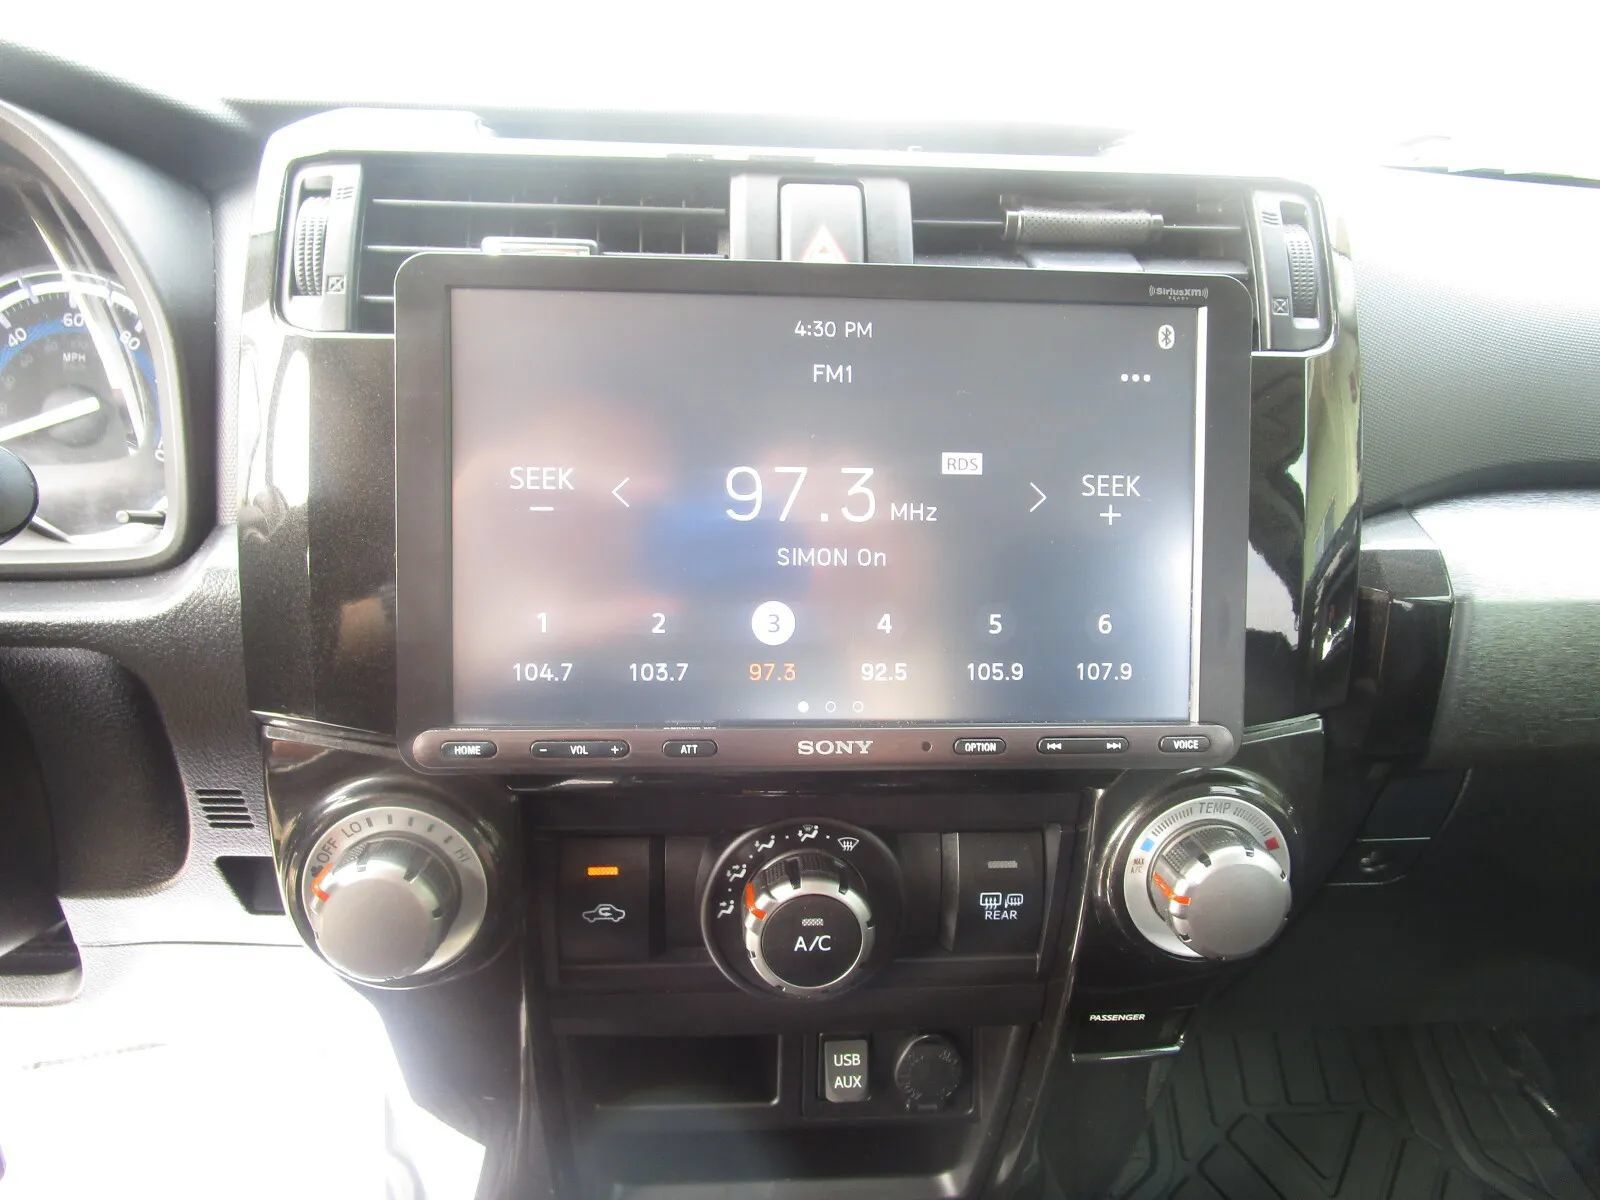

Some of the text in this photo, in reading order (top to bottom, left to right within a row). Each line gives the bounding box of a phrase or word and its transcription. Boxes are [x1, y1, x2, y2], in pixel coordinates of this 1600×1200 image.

[63, 312, 84, 327] 60
[8, 328, 27, 347] 40
[794, 320, 873, 338] 4:30 PM
[119, 331, 140, 350] 80
[63, 352, 86, 361] MPH
[812, 364, 853, 384] FM1
[946, 456, 979, 472] RDS
[509, 466, 575, 491] SEEK
[1080, 474, 1141, 498] SEEK
[725, 465, 938, 523] 97.3 MHz
[776, 547, 888, 567] SIMON On
[537, 612, 549, 633] 1
[651, 612, 666, 634] 2
[766, 613, 781, 634] 3
[876, 613, 893, 634] 4
[988, 613, 1003, 635] 5
[1098, 613, 1113, 635] 6
[512, 662, 574, 682] 104.7
[628, 662, 690, 682] 103.7
[748, 663, 796, 681] 97.3
[860, 662, 908, 682] 92.5
[967, 662, 1025, 682] 105.9
[1076, 662, 1134, 682] 107.9
[454, 745, 482, 756] HOME
[569, 745, 589, 756] VOL
[680, 745, 699, 755] ATT
[797, 740, 874, 756] SONY
[964, 742, 998, 753] OPTION
[1173, 739, 1200, 750] VOICE
[1199, 802, 1231, 815] TEMP
[341, 821, 362, 838] LO
[316, 838, 338, 864] OFF
[455, 849, 472, 864] HI
[985, 910, 1018, 921] REAR
[793, 935, 832, 953] A/C
[1089, 1012, 1146, 1022] PASSENGER
[833, 1054, 861, 1067] USB
[834, 1076, 862, 1089] AUX
